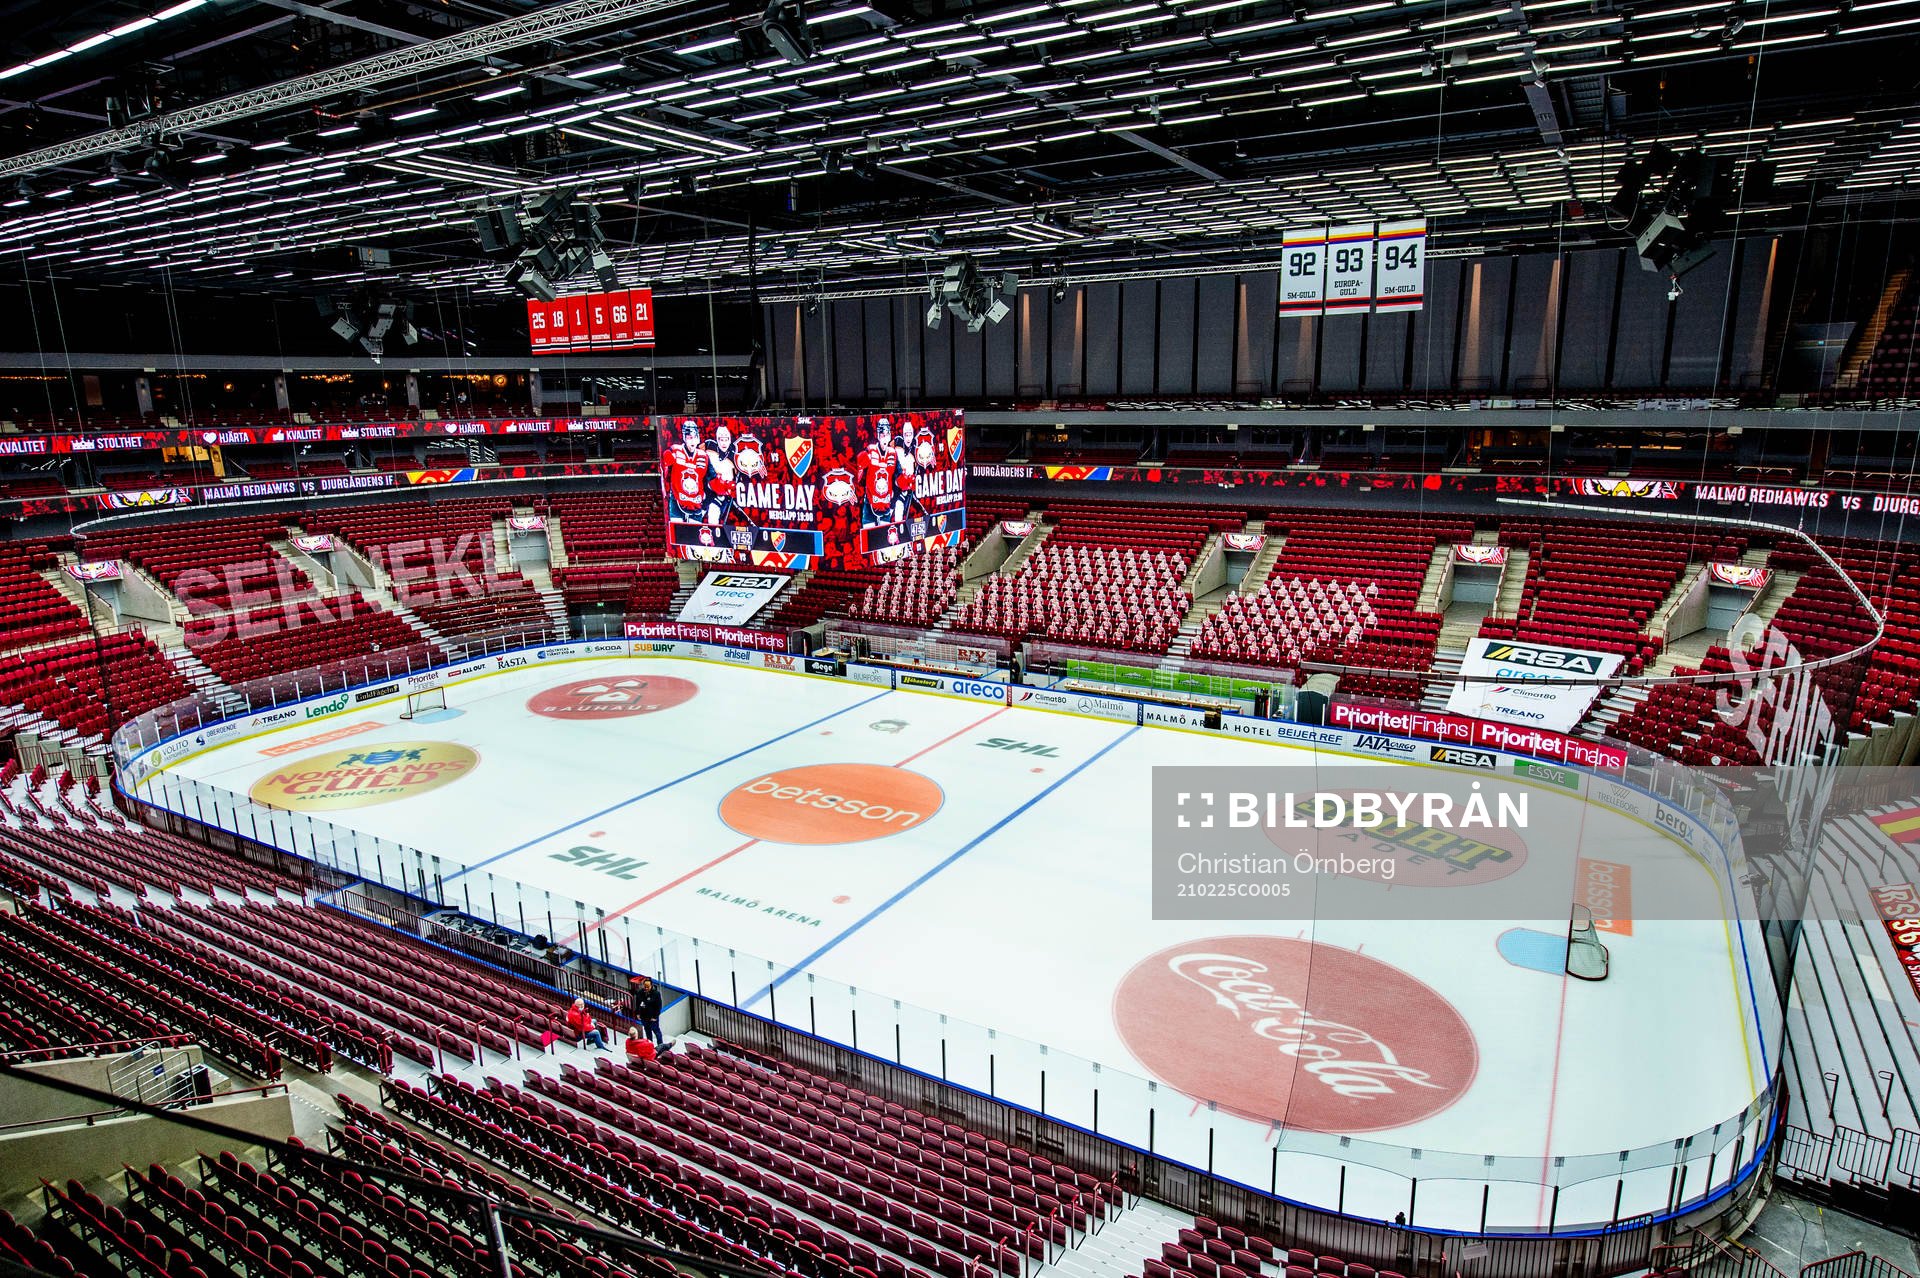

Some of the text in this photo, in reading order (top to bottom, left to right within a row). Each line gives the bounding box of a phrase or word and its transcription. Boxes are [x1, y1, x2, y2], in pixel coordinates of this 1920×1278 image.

[1289, 252, 1316, 276] 92
[1336, 247, 1363, 273] 93
[1385, 243, 1418, 271] 94
[1334, 280, 1364, 288] EUROPA-
[1339, 288, 1357, 296] GULD
[1385, 284, 1416, 294] SM-GULD
[1287, 290, 1316, 299] SM-GULD
[532, 312, 545, 329] 25
[552, 310, 564, 327] 18
[576, 308, 582, 326] 1
[595, 307, 603, 324] 5
[613, 305, 628, 323] 66
[636, 303, 649, 321] 21
[360, 426, 396, 438] STOLTHET
[459, 423, 486, 433] HJÄRTA
[518, 421, 550, 432] KVALITET
[584, 420, 617, 430] STOLTHET
[97, 436, 142, 449] STOLTHET
[218, 431, 249, 443] HJÄRTA
[286, 429, 322, 440] KVALITET
[973, 466, 1033, 478] DJURGÅRDENS IF
[203, 475, 394, 501] MALMÖ REDHAWKS VS DJURGÅRDENS IF
[916, 468, 963, 498] GAME DAY
[736, 482, 815, 510] GAME DAY
[1695, 485, 1920, 515] MALMÖ REDHAWKS VS DJURG
[726, 577, 772, 588] RSA
[715, 590, 754, 599] areco
[627, 624, 709, 638] Prioritet Finans
[715, 628, 784, 648] Prioritet Finans
[634, 643, 675, 652] SUBWAY
[724, 649, 750, 660] ahlsell
[498, 657, 527, 669] RASTA
[763, 654, 795, 665] RIV
[1508, 648, 1594, 673] RSA
[408, 671, 439, 685] Prioritet
[953, 680, 1005, 699] areco
[1512, 688, 1556, 700] Climat80
[1035, 693, 1067, 704] Climat80
[1094, 698, 1124, 711] Malmö
[306, 702, 345, 718] Lendo
[543, 704, 662, 712] BAUHAUS
[1496, 706, 1545, 719] TREANO
[262, 710, 297, 724] TREANO
[1146, 711, 1187, 725] MALMÖ
[1191, 719, 1229, 731] ARA
[1234, 724, 1272, 737] HOTEL
[1336, 705, 1468, 737] Prioritet Finans
[1278, 727, 1343, 744] BEIJER REF
[1353, 734, 1416, 751] JATA CARGO
[162, 740, 189, 755] VOLITO
[975, 737, 1060, 758] SHL
[1482, 724, 1620, 770] Prioritet Finans
[1444, 750, 1496, 768] RSA
[265, 759, 469, 787] NORRLANDS
[1528, 764, 1566, 785] ESSVE
[281, 769, 441, 796] GULD
[295, 787, 406, 802] ALKOHOLFRI
[742, 776, 922, 828] betsson
[1597, 790, 1640, 816] TRELLEBORG
[1655, 802, 1694, 841] bergx
[546, 845, 650, 881] SHL
[695, 886, 823, 928] MALMÖ ARENA
